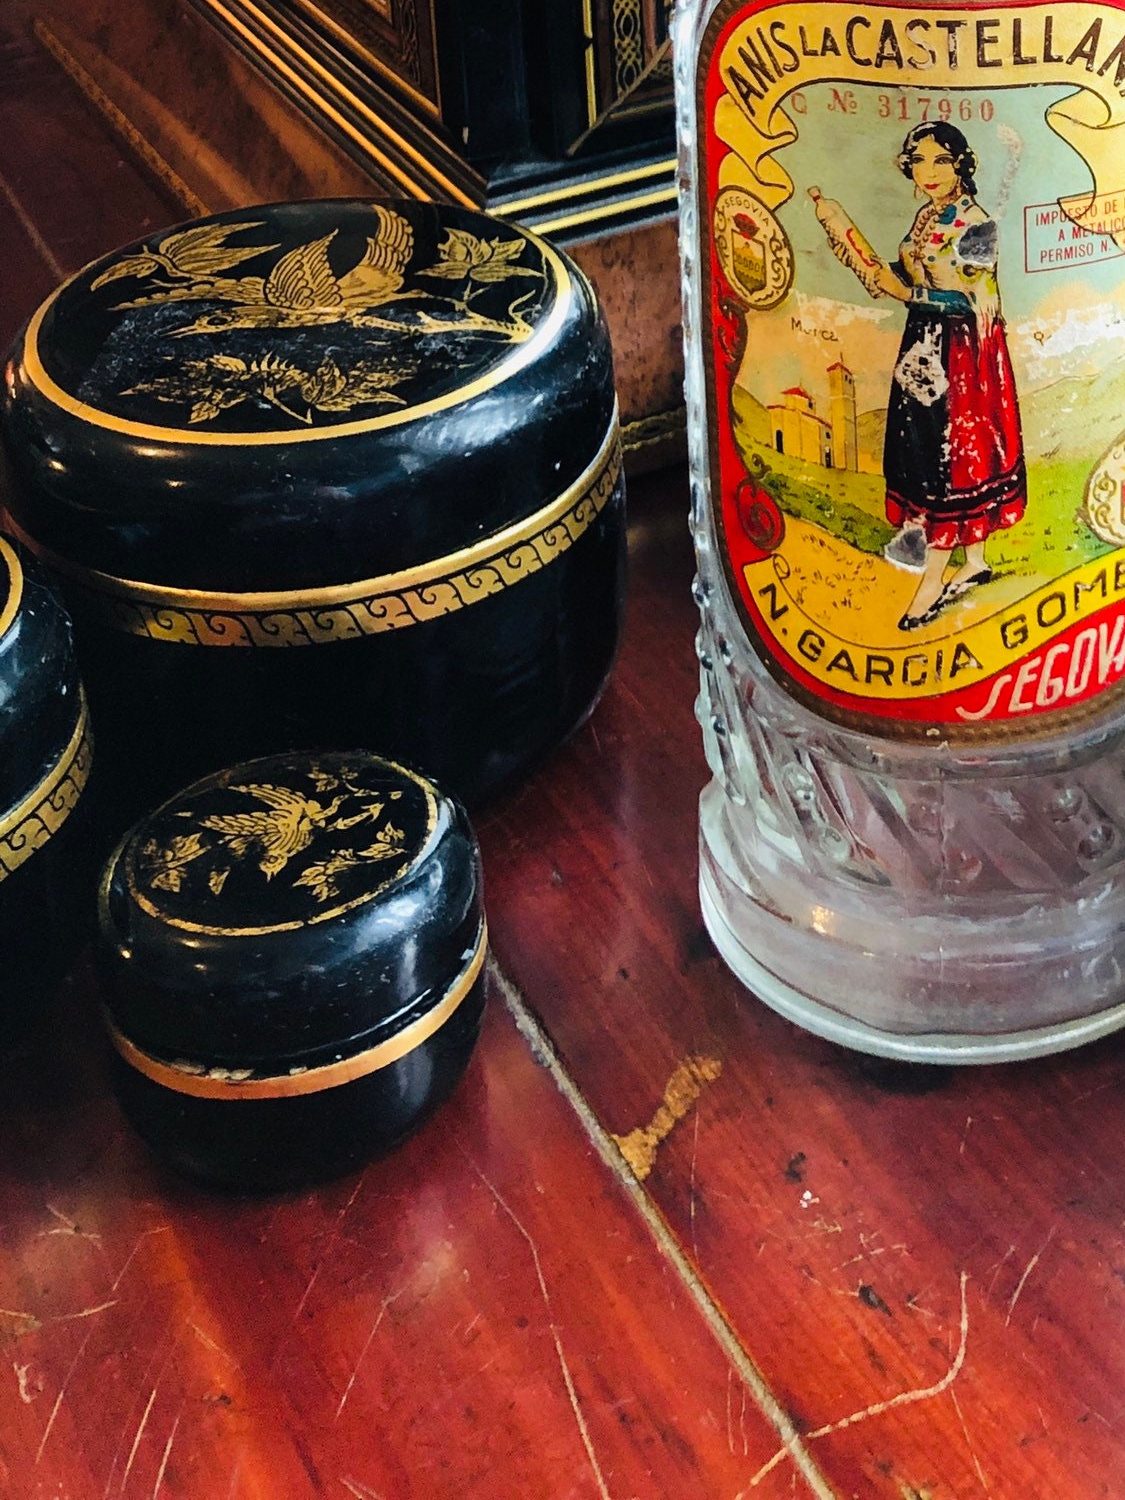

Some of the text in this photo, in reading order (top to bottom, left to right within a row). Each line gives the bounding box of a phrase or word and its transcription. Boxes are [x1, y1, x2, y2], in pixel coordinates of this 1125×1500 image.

[725, 20, 799, 117] ANIS
[799, 24, 841, 57] LA
[878, 94, 995, 122] 317960
[725, 196, 769, 227] SEGOVIA
[1036, 204, 1098, 226] IMPUESTO
[1104, 201, 1118, 215] DE
[1058, 229, 1065, 242] A
[1040, 242, 1094, 264] PERMISO
[758, 581, 788, 636] N.
[797, 629, 984, 689] GARCIA
